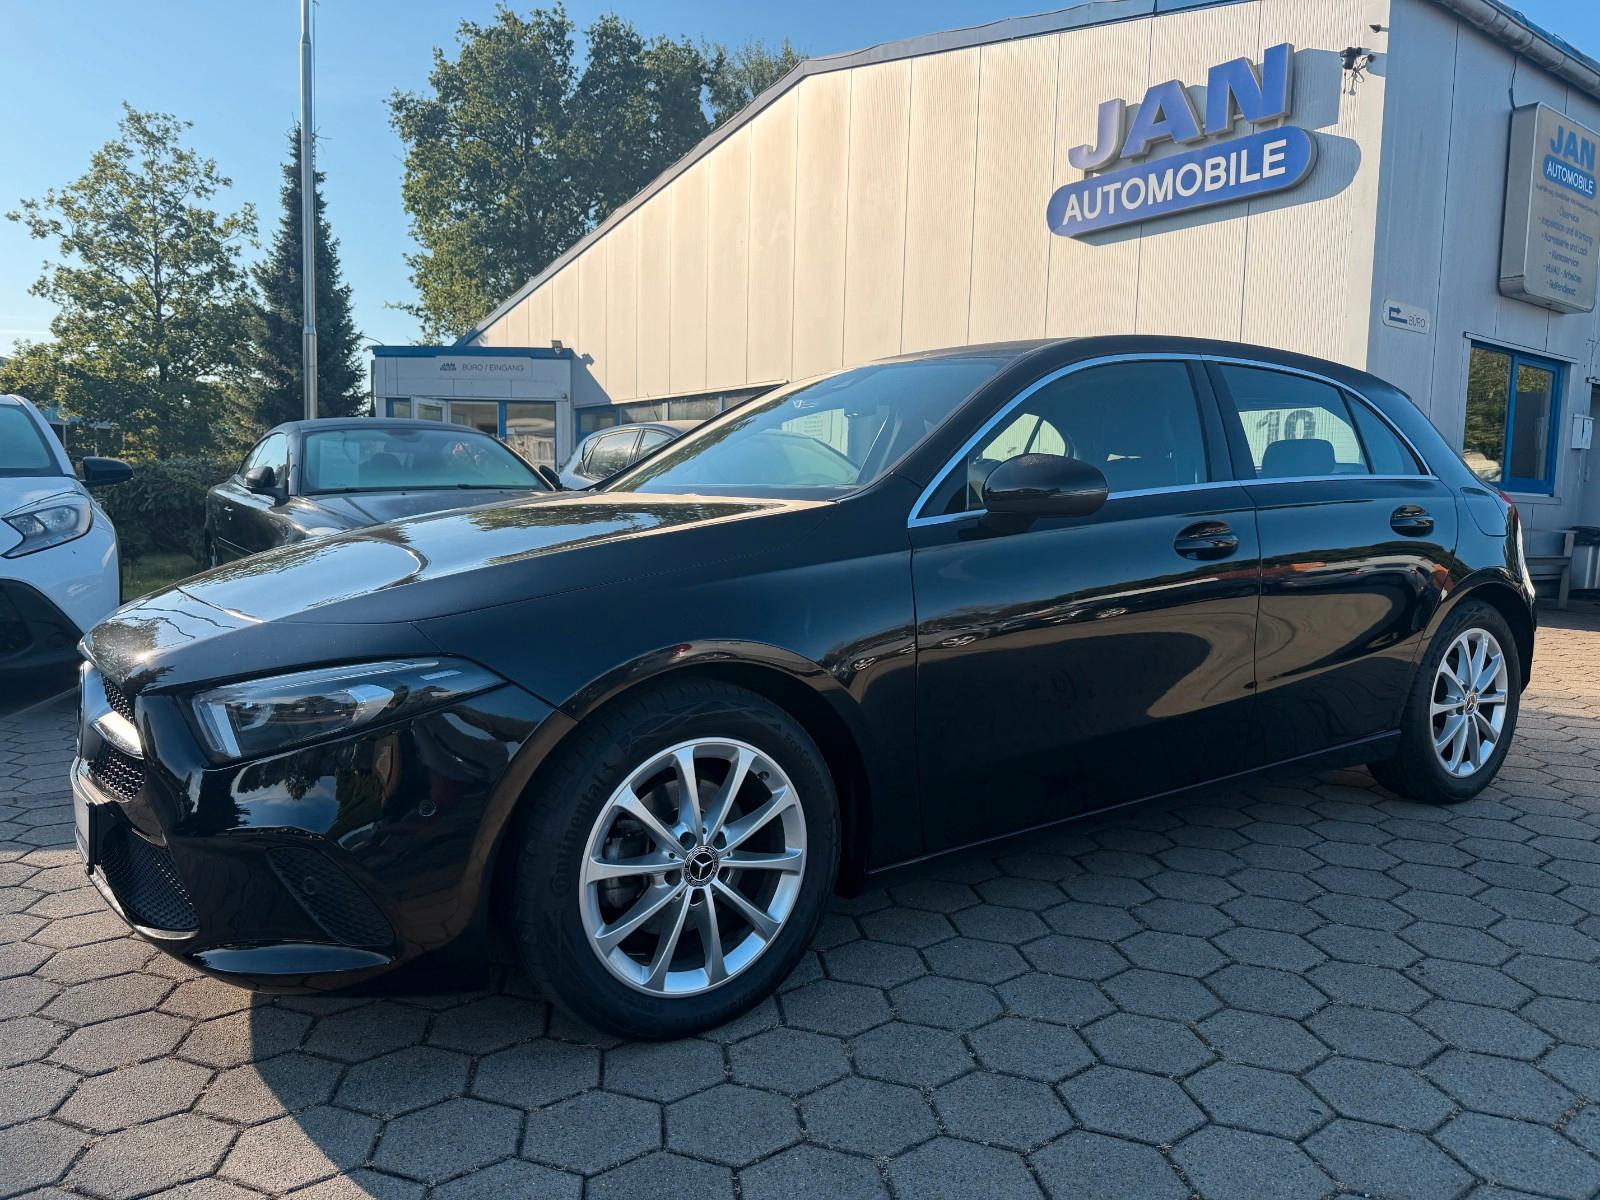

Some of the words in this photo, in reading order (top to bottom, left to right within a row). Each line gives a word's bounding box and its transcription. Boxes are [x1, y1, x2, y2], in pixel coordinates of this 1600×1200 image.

[1068, 42, 1295, 171] JAN
[1550, 125, 1596, 172] JAN
[1062, 138, 1287, 225] AUTOMOBILE
[1546, 160, 1594, 195] AUTOMOBILE
[1408, 313, 1426, 328] BÜRO
[462, 363, 484, 372] BÜRO
[489, 363, 524, 372] EINGANG
